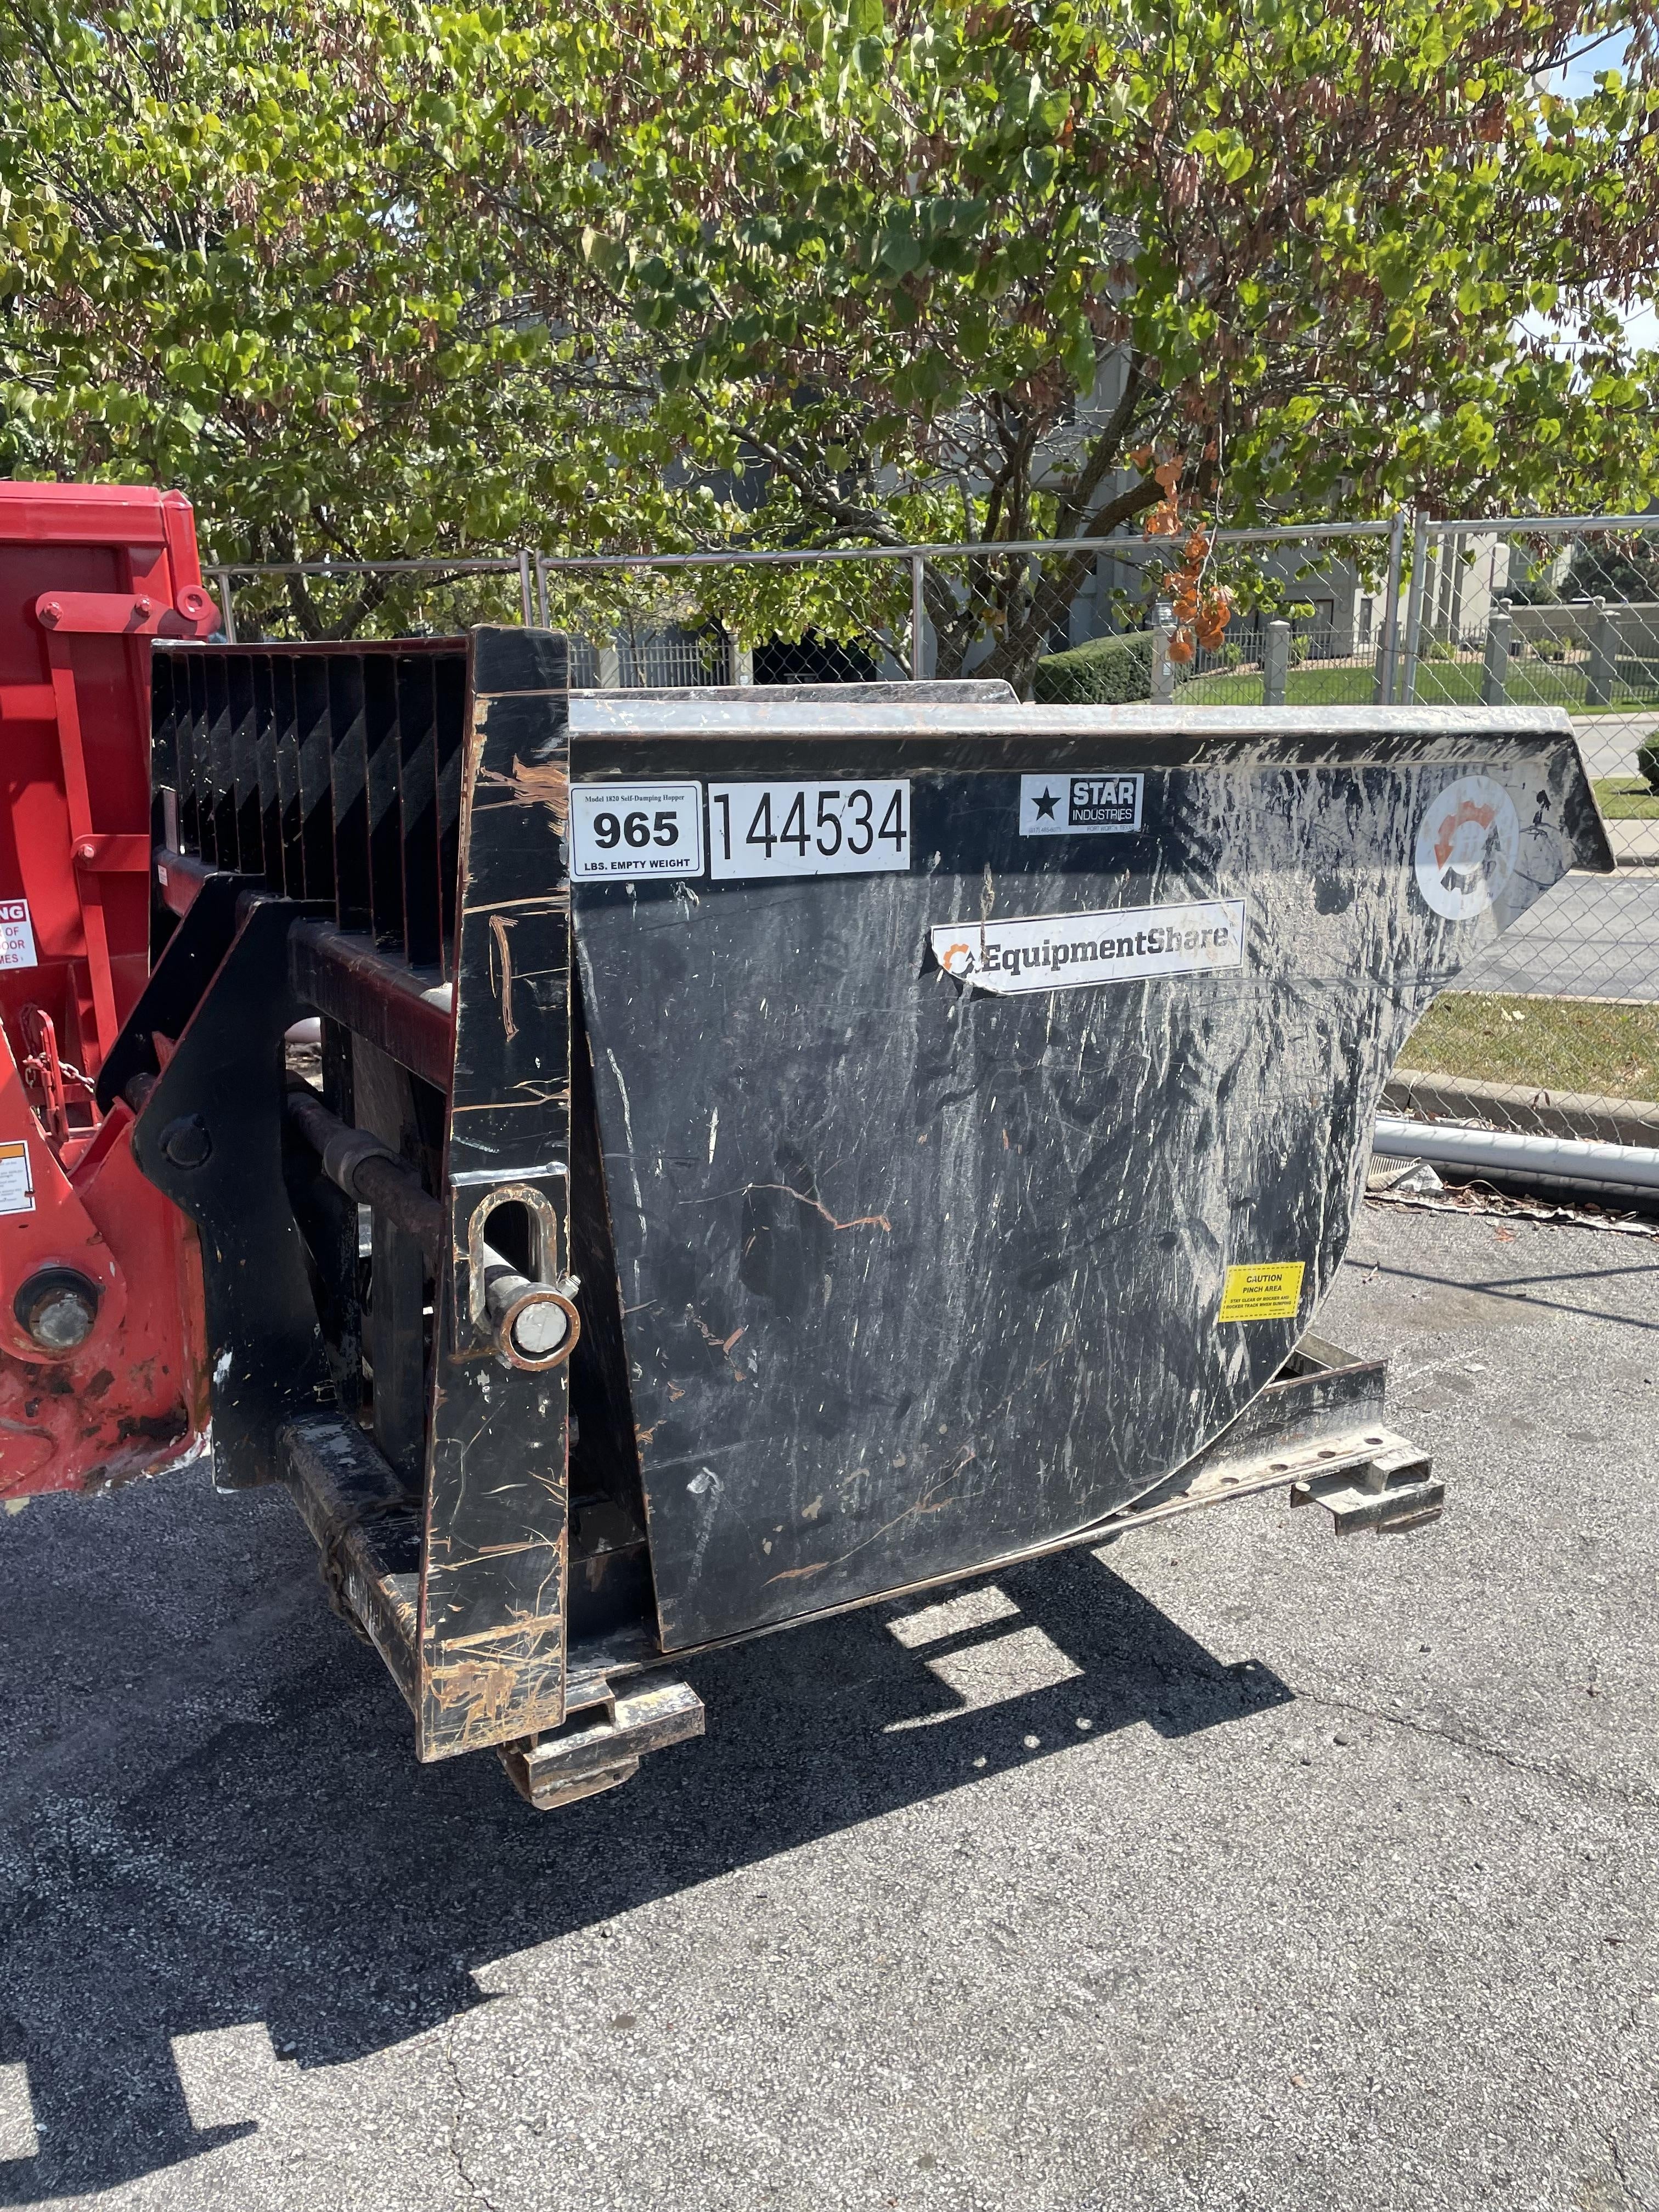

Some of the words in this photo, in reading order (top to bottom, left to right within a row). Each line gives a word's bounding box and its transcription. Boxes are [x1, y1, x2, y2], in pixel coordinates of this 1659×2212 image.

[621, 794, 662, 803] Self-Dumping
[663, 794, 685, 802] Hopper
[1073, 781, 1134, 806] STAR
[1073, 809, 1132, 821] INDUSTRIES
[594, 811, 679, 848] 965
[714, 789, 907, 860] 144534
[584, 862, 608, 871] LBS.
[611, 860, 647, 870] EMPTY
[650, 859, 690, 868] WEIGHT
[5, 926, 19, 936] OF
[981, 927, 1228, 976] EquipmentShare
[1246, 1274, 1283, 1283] CAUTION
